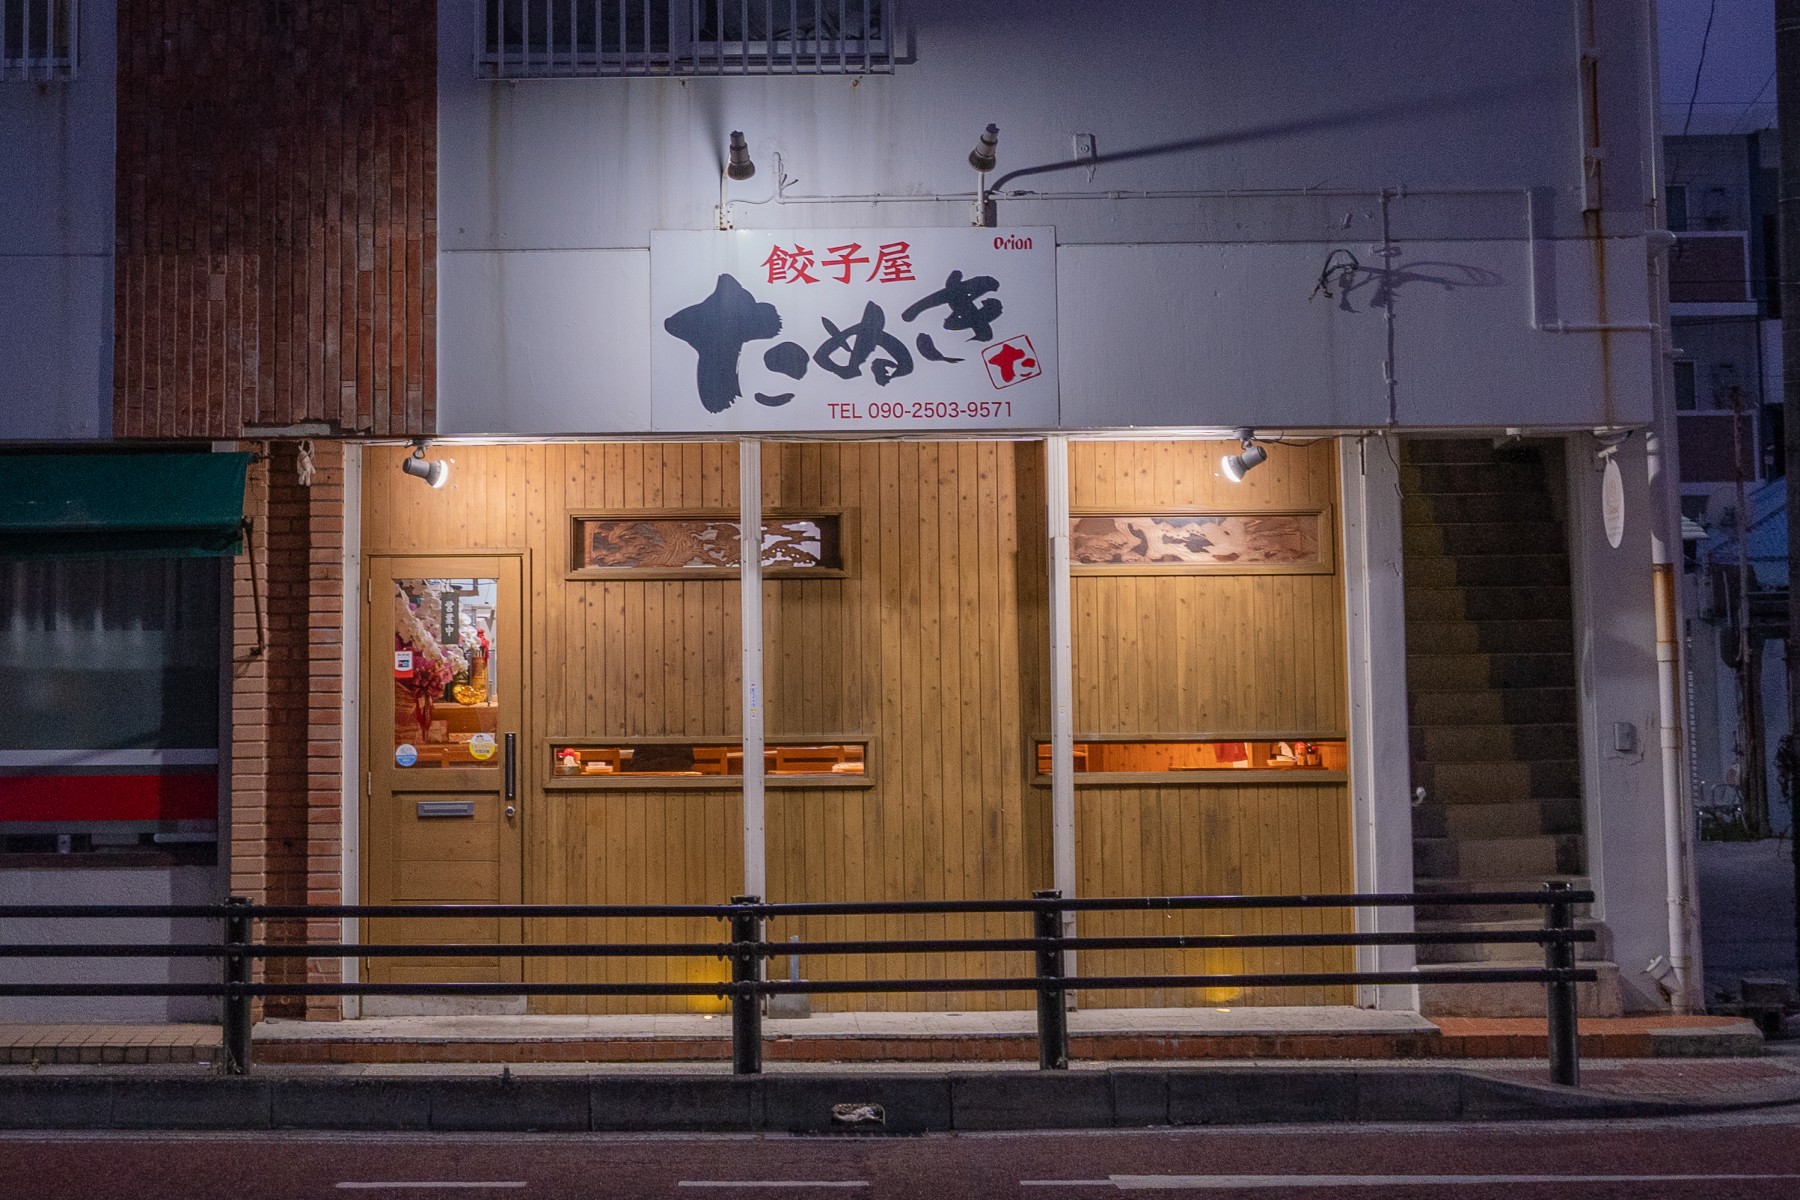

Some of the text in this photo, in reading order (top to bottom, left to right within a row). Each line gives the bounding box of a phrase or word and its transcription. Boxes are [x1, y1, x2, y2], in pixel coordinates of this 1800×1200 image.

[994, 234, 1033, 250] Orion
[761, 241, 916, 284] 餃子屋
[664, 270, 1004, 414] たぬき
[988, 343, 1036, 383] た
[827, 402, 1012, 419] TEL 090-2503-9571
